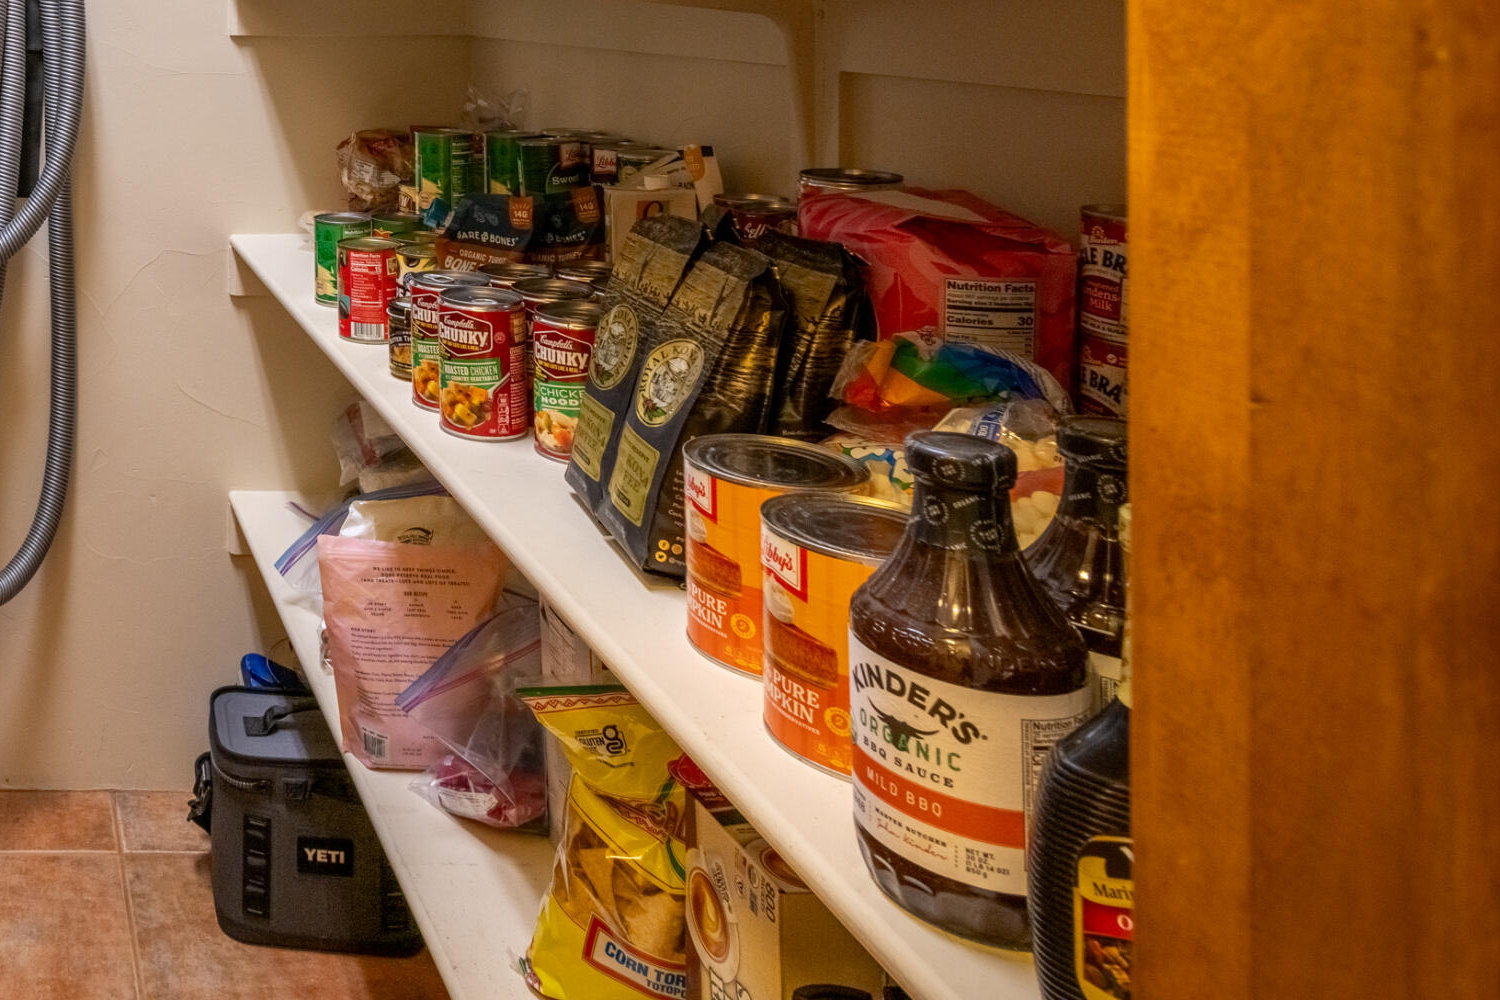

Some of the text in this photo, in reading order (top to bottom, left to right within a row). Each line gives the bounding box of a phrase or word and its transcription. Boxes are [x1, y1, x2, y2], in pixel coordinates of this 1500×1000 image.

[552, 174, 580, 186] Sweet
[513, 210, 528, 218] 14G
[457, 231, 517, 246] BARE BONES
[459, 249, 487, 261] ORGANIC
[1102, 250, 1127, 276] BR
[444, 256, 476, 272] BONE
[947, 281, 1035, 293] Nutrition Facts
[1089, 297, 1112, 312] Milk
[443, 315, 476, 329] Campbell's
[946, 315, 1034, 326] Calories 30
[439, 320, 489, 347] CHUNKY
[540, 334, 573, 350] Campbell's
[535, 341, 589, 369] CHUNKY
[444, 366, 498, 376] ROASTED CHICKEN
[639, 351, 666, 393] ROYAL
[540, 386, 585, 399] CHICKE
[541, 396, 583, 406] NOOD
[691, 582, 728, 616] PURE
[773, 668, 820, 709] PURE
[764, 681, 814, 724] MPKIN
[852, 662, 982, 745] KINDER'S
[1032, 716, 1072, 731] Nutrition
[578, 736, 604, 746] GLUTEN
[859, 707, 962, 772] ORGANIC
[863, 736, 954, 788] BBQ SAUCE
[866, 765, 943, 818] MILD BBQ
[874, 807, 947, 848] MASTER BUTCHER
[303, 847, 346, 865] YETI
[965, 847, 982, 857] NET
[965, 854, 977, 863] 30
[973, 861, 984, 870] LB
[764, 882, 776, 924] 800
[604, 940, 686, 989] CORN TOR
